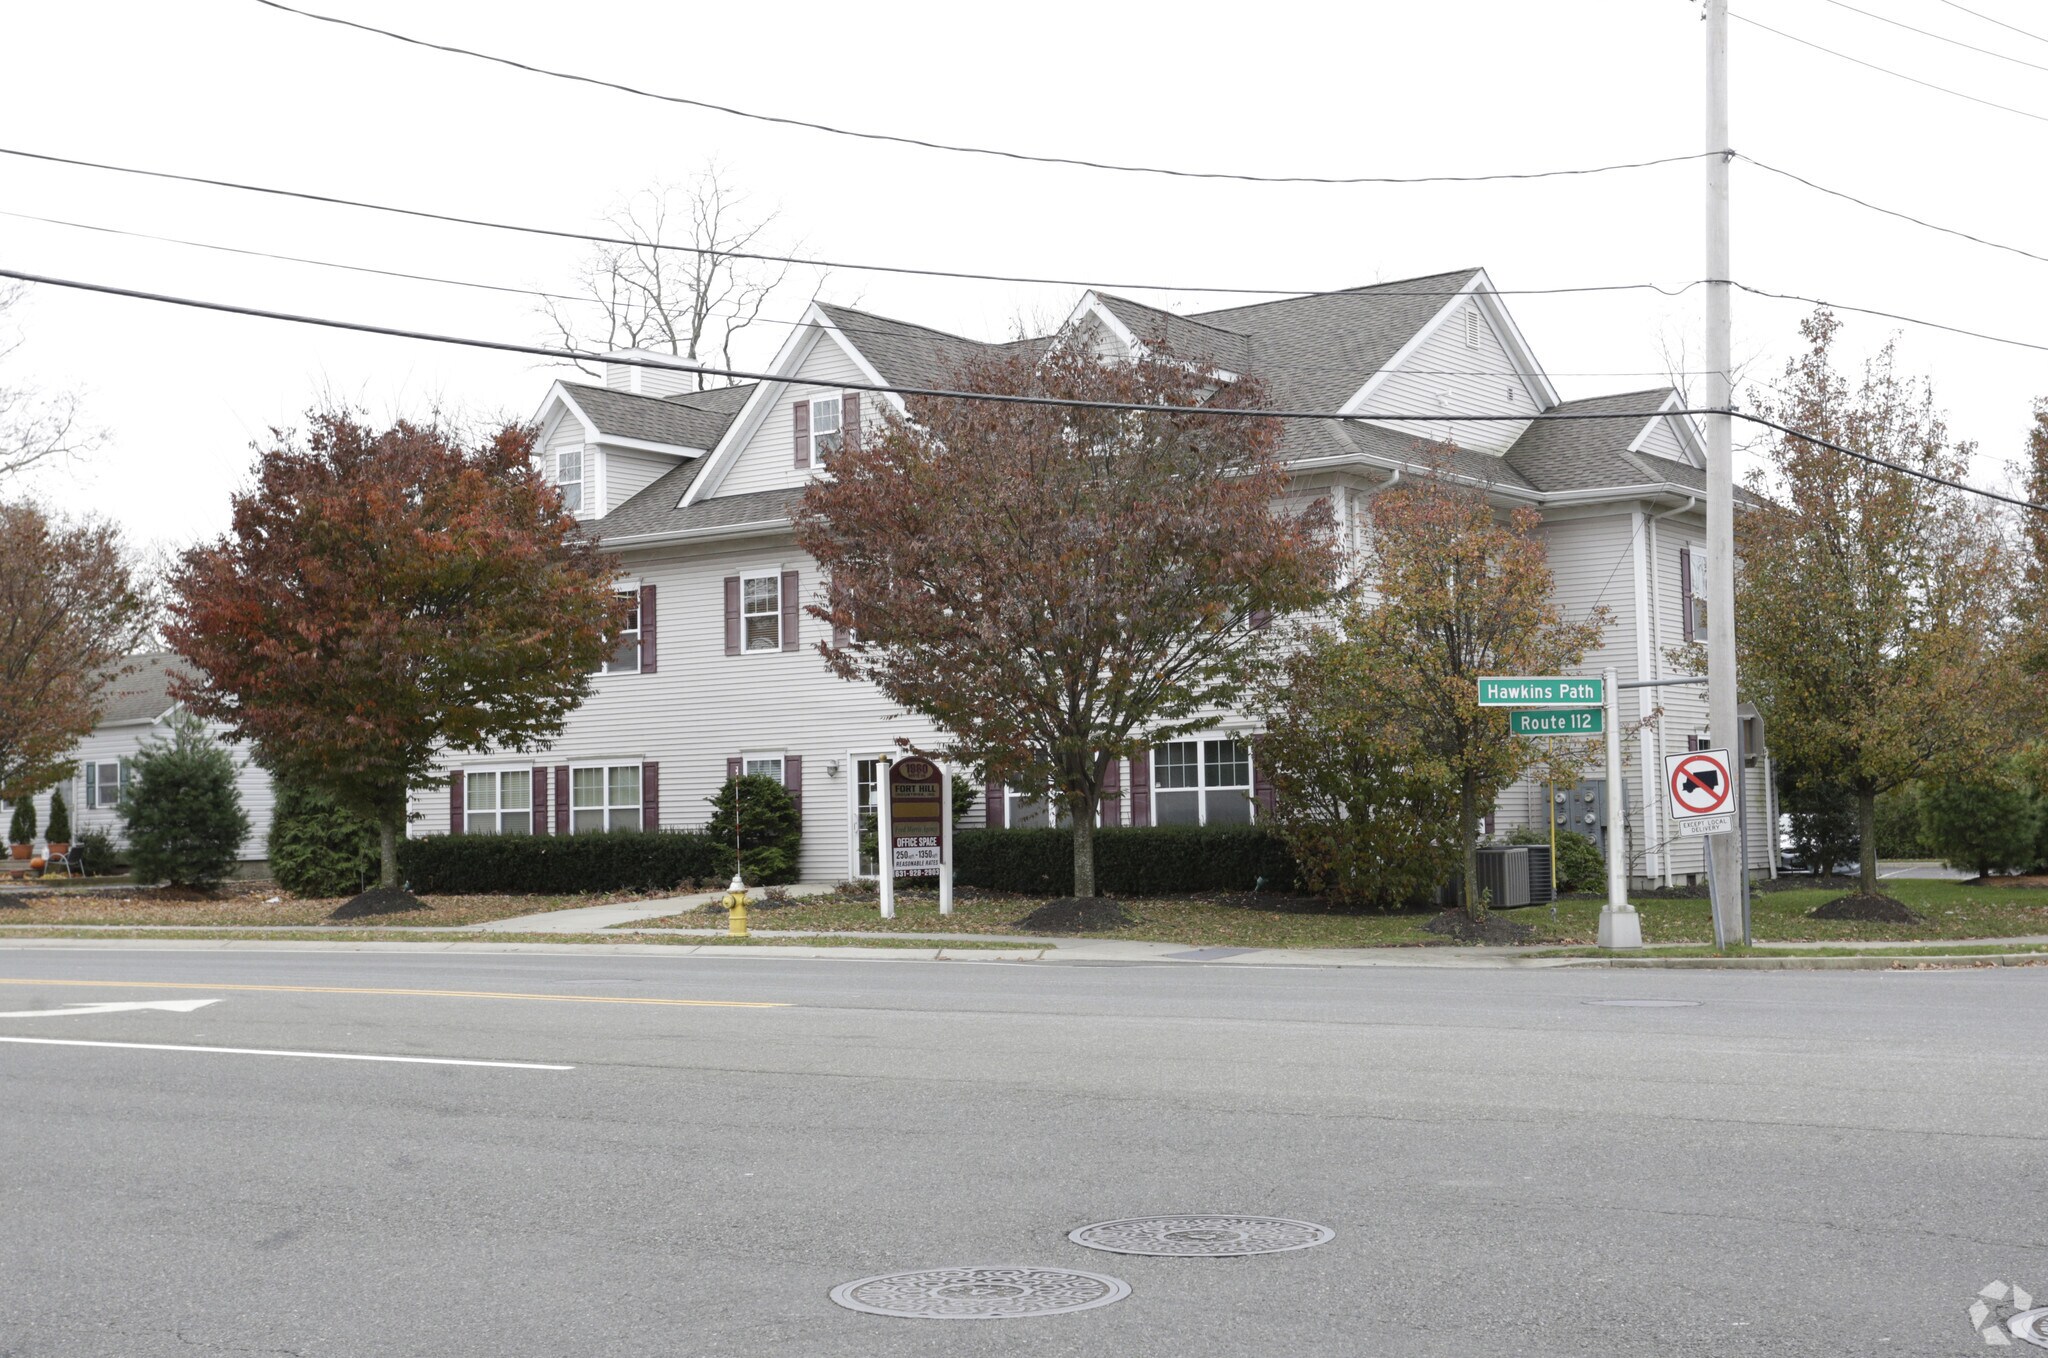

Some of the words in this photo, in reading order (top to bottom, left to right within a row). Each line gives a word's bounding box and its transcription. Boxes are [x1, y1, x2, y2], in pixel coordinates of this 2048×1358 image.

[1487, 684, 1553, 699] Hawkins
[1559, 683, 1594, 699] Path
[1521, 715, 1566, 730] Route
[1570, 714, 1592, 729] 112
[895, 784, 916, 793] FORT
[919, 784, 936, 793] HILL
[1683, 820, 1705, 829] EXCEPT
[1707, 818, 1728, 826] LOCAL
[1691, 825, 1720, 833] DELIVERY
[896, 837, 918, 847] OFFICE
[918, 836, 937, 846] SPACE
[896, 850, 909, 859] 250
